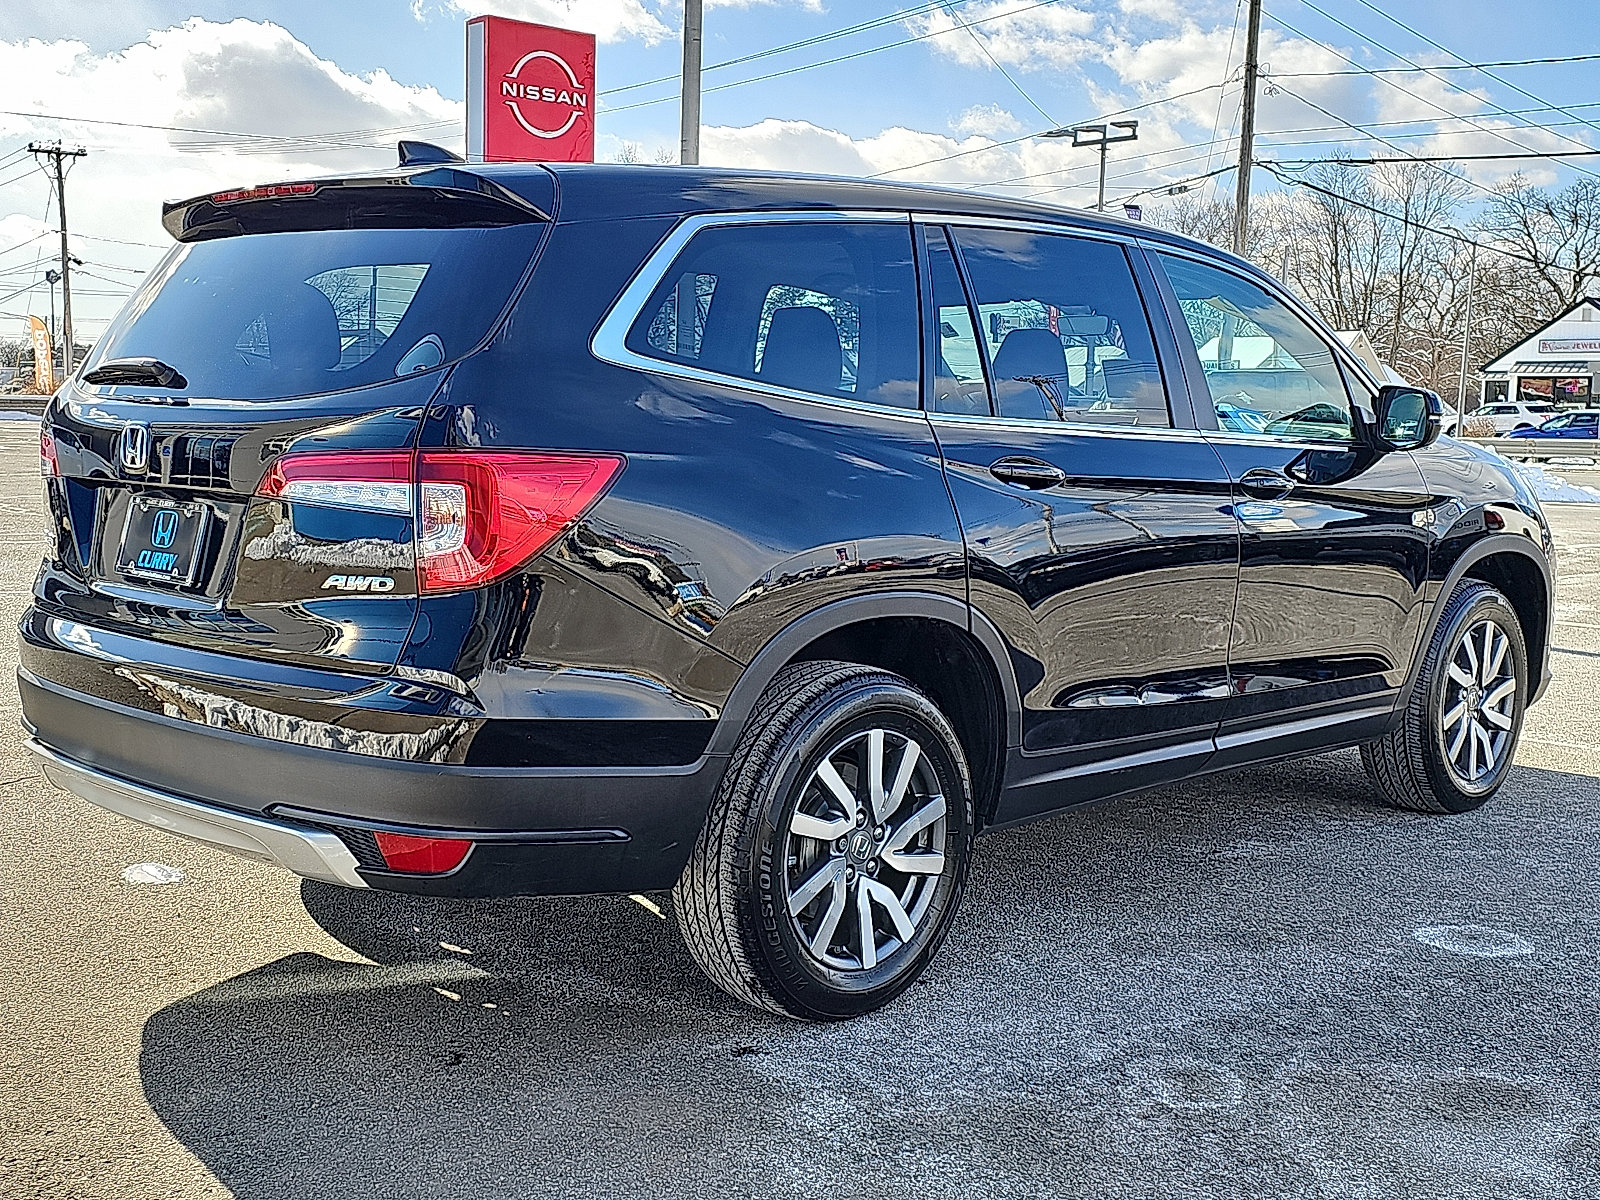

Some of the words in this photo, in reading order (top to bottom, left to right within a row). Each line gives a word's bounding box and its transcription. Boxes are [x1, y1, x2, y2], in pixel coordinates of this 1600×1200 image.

[501, 81, 587, 107] NISSAN
[137, 549, 179, 571] CURRY
[321, 574, 396, 592] AWD
